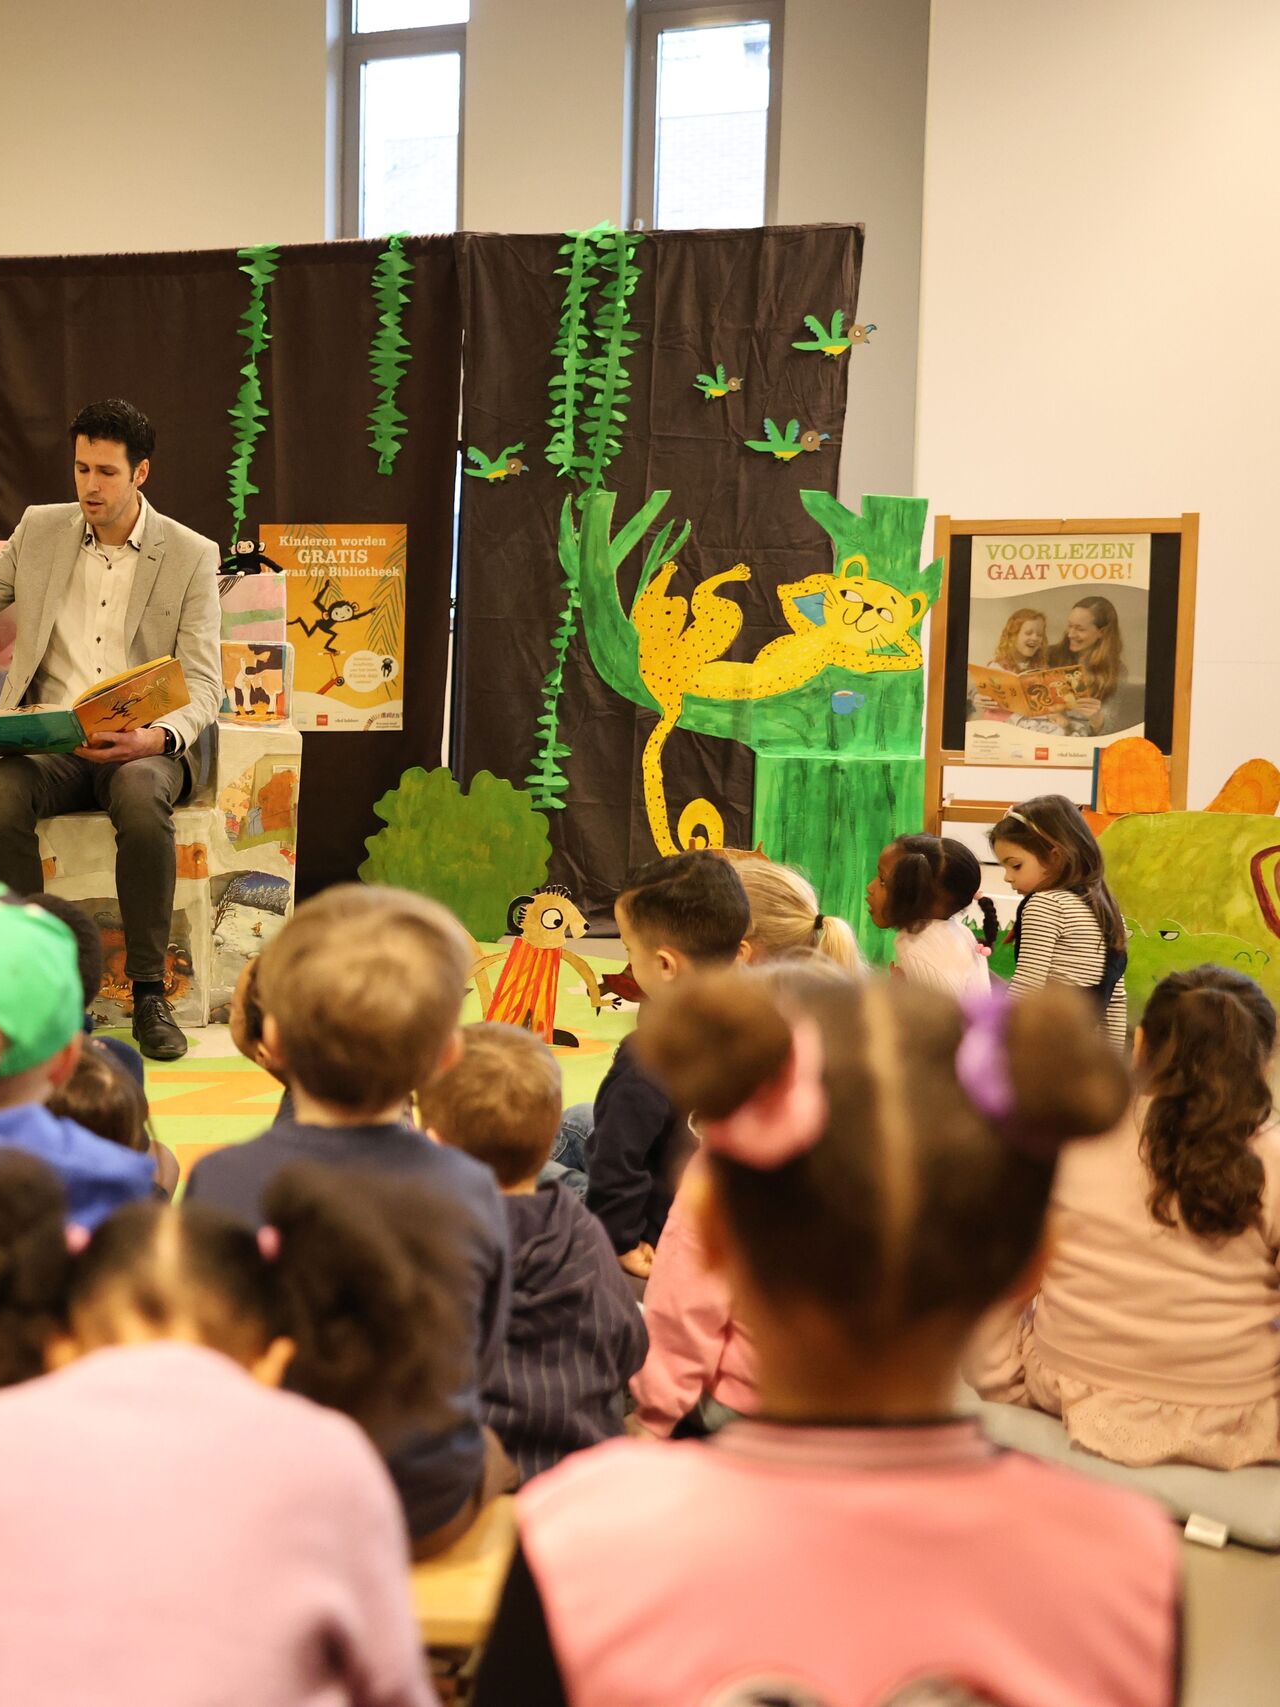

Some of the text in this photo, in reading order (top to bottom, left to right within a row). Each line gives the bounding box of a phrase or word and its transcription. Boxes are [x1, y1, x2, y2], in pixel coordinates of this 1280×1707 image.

[279, 536, 387, 546] Kinderen worden
[297, 549, 368, 564] GRATIS
[985, 543, 1136, 560] VOORLEZEN
[310, 566, 325, 577] de
[329, 566, 400, 577] Bibliotheek
[987, 563, 1132, 580] GAAT VOOR!
